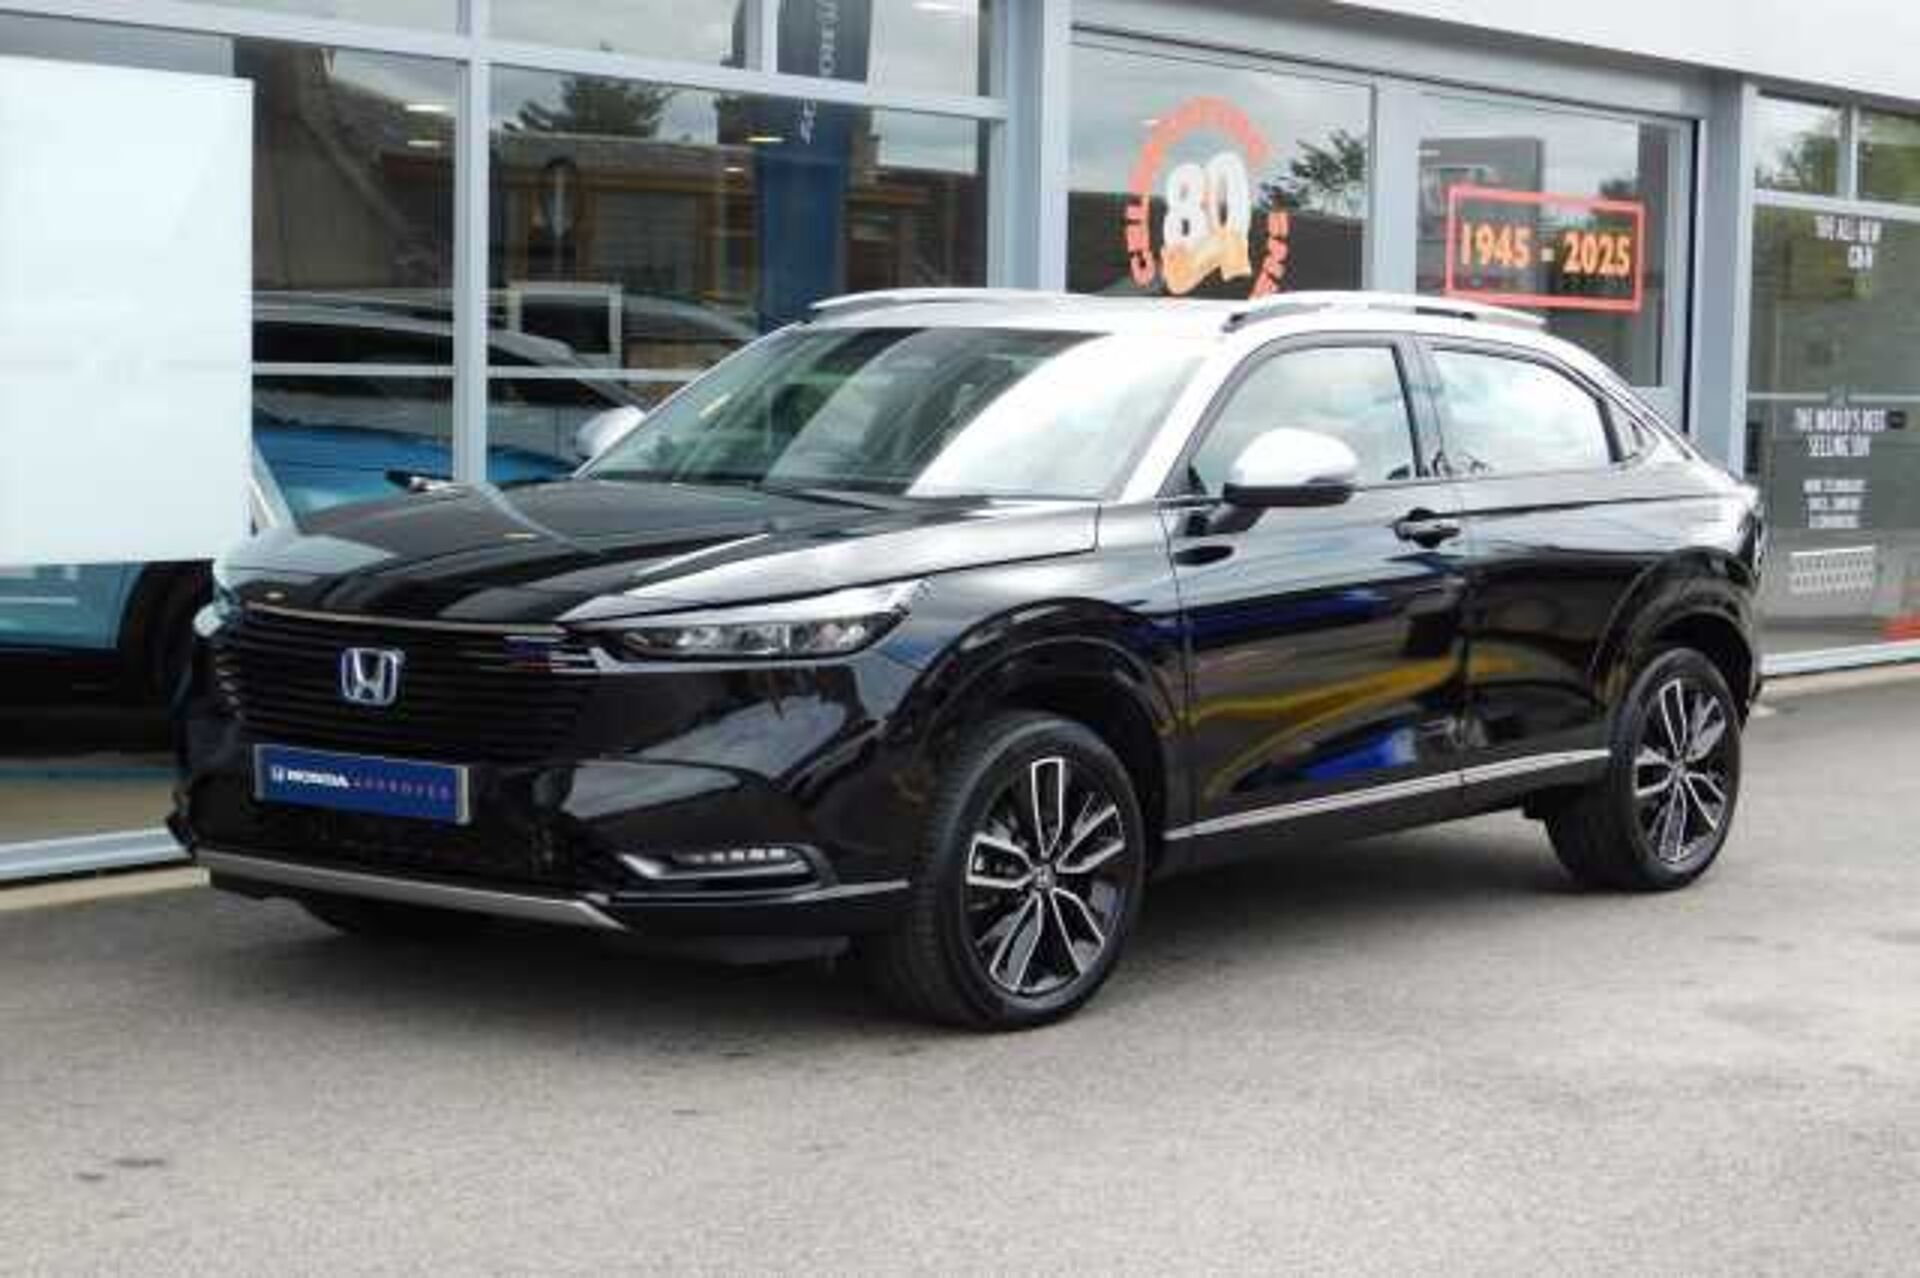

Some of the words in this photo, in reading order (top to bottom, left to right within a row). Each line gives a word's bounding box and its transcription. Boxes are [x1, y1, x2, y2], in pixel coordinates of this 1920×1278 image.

[1164, 151, 1250, 244] 80
[1461, 221, 1531, 268] 1945
[1563, 230, 1631, 276] 2025
[286, 769, 349, 788] HONDA
